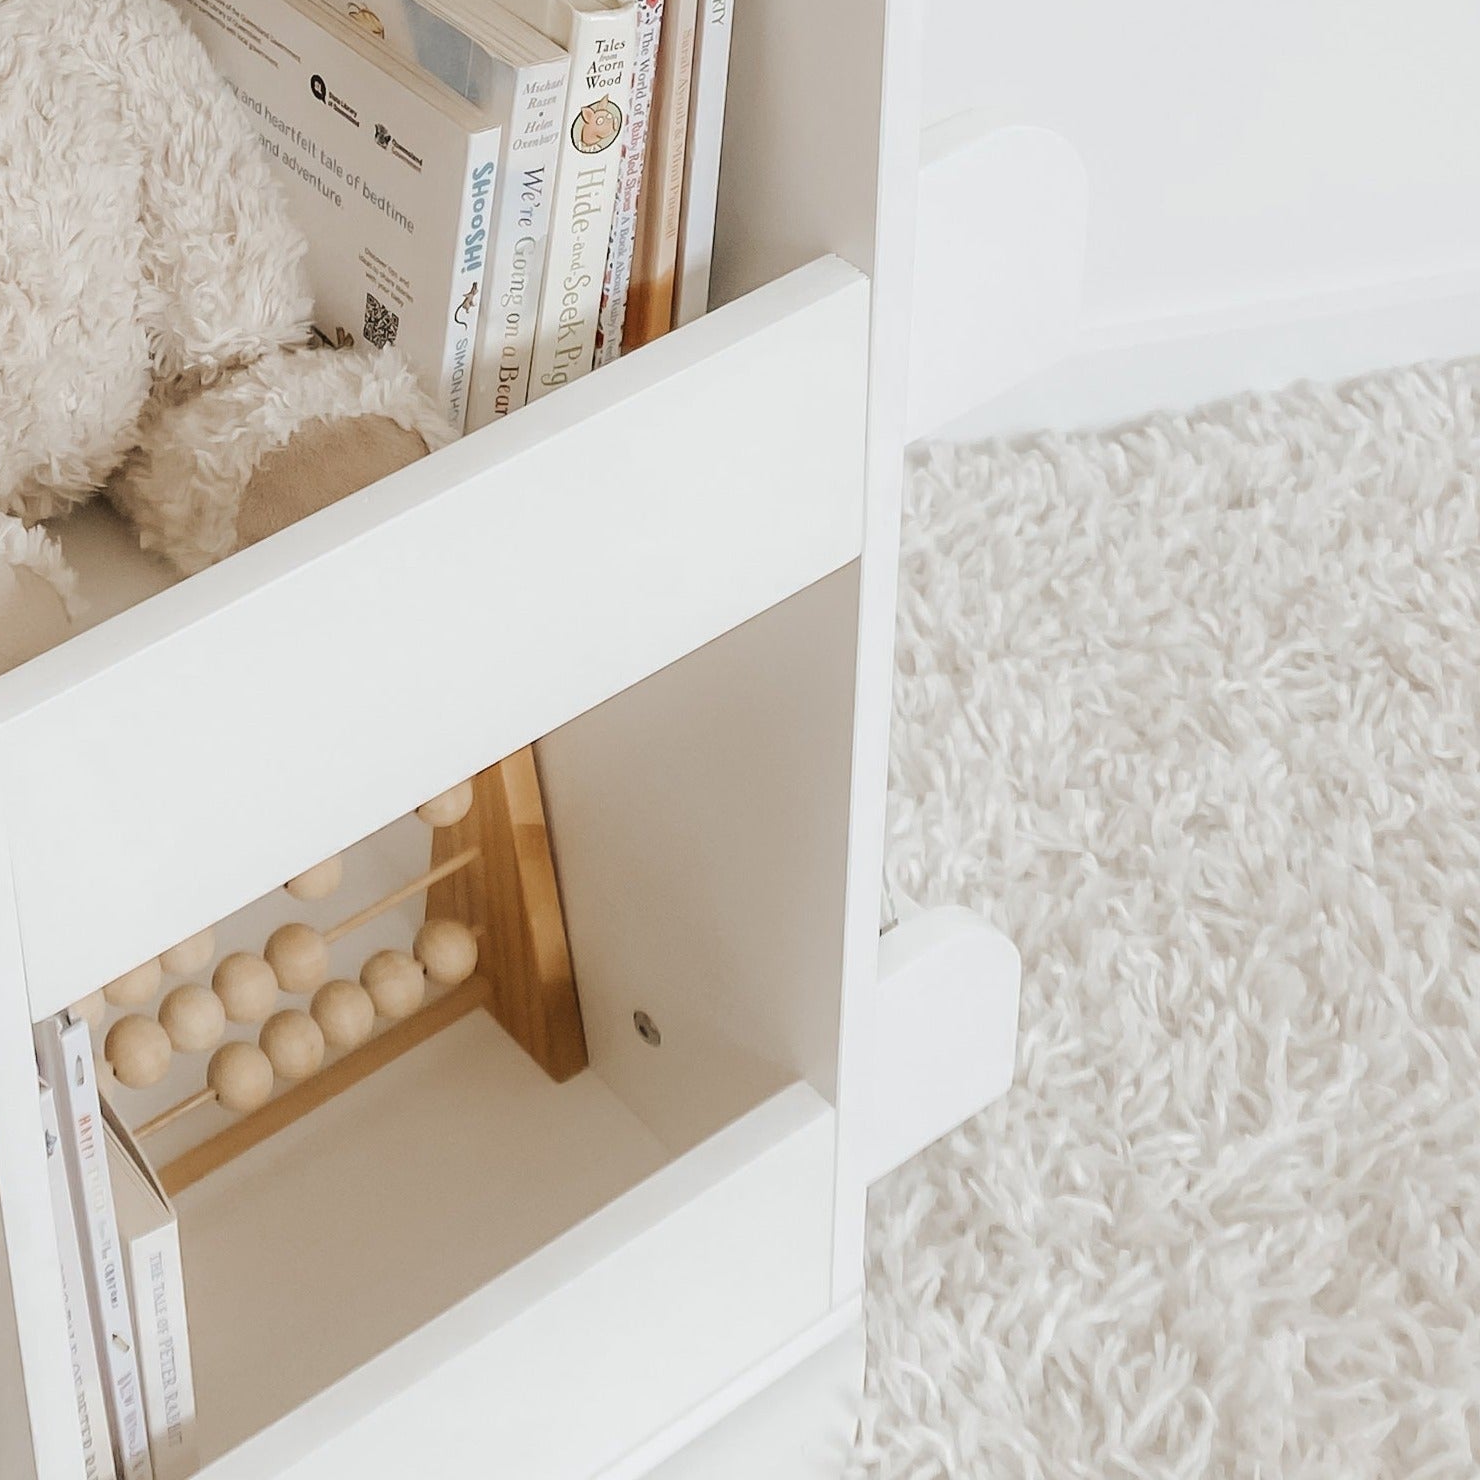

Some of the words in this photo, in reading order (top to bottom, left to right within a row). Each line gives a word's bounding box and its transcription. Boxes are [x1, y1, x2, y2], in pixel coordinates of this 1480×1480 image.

[595, 38, 627, 55] Tales
[639, 31, 655, 57] The
[585, 71, 624, 91] Wood
[586, 60, 625, 76] Acorn
[632, 57, 652, 102] World
[632, 100, 644, 118] of
[258, 132, 280, 158] and
[626, 117, 645, 154] Ruby
[241, 90, 262, 117] and
[264, 106, 316, 160] heartfelt
[319, 149, 344, 180] tale
[346, 172, 361, 191] of
[362, 181, 415, 235] bedtime
[625, 151, 641, 179] Red
[518, 166, 546, 228] We're
[620, 177, 638, 212] Shoes
[617, 225, 632, 261] Book
[500, 235, 536, 308] Going
[505, 311, 521, 339] on
[449, 337, 469, 396] SIMON
[502, 345, 517, 358] a
[540, 343, 583, 387] Pig
[494, 364, 520, 416] Bear
